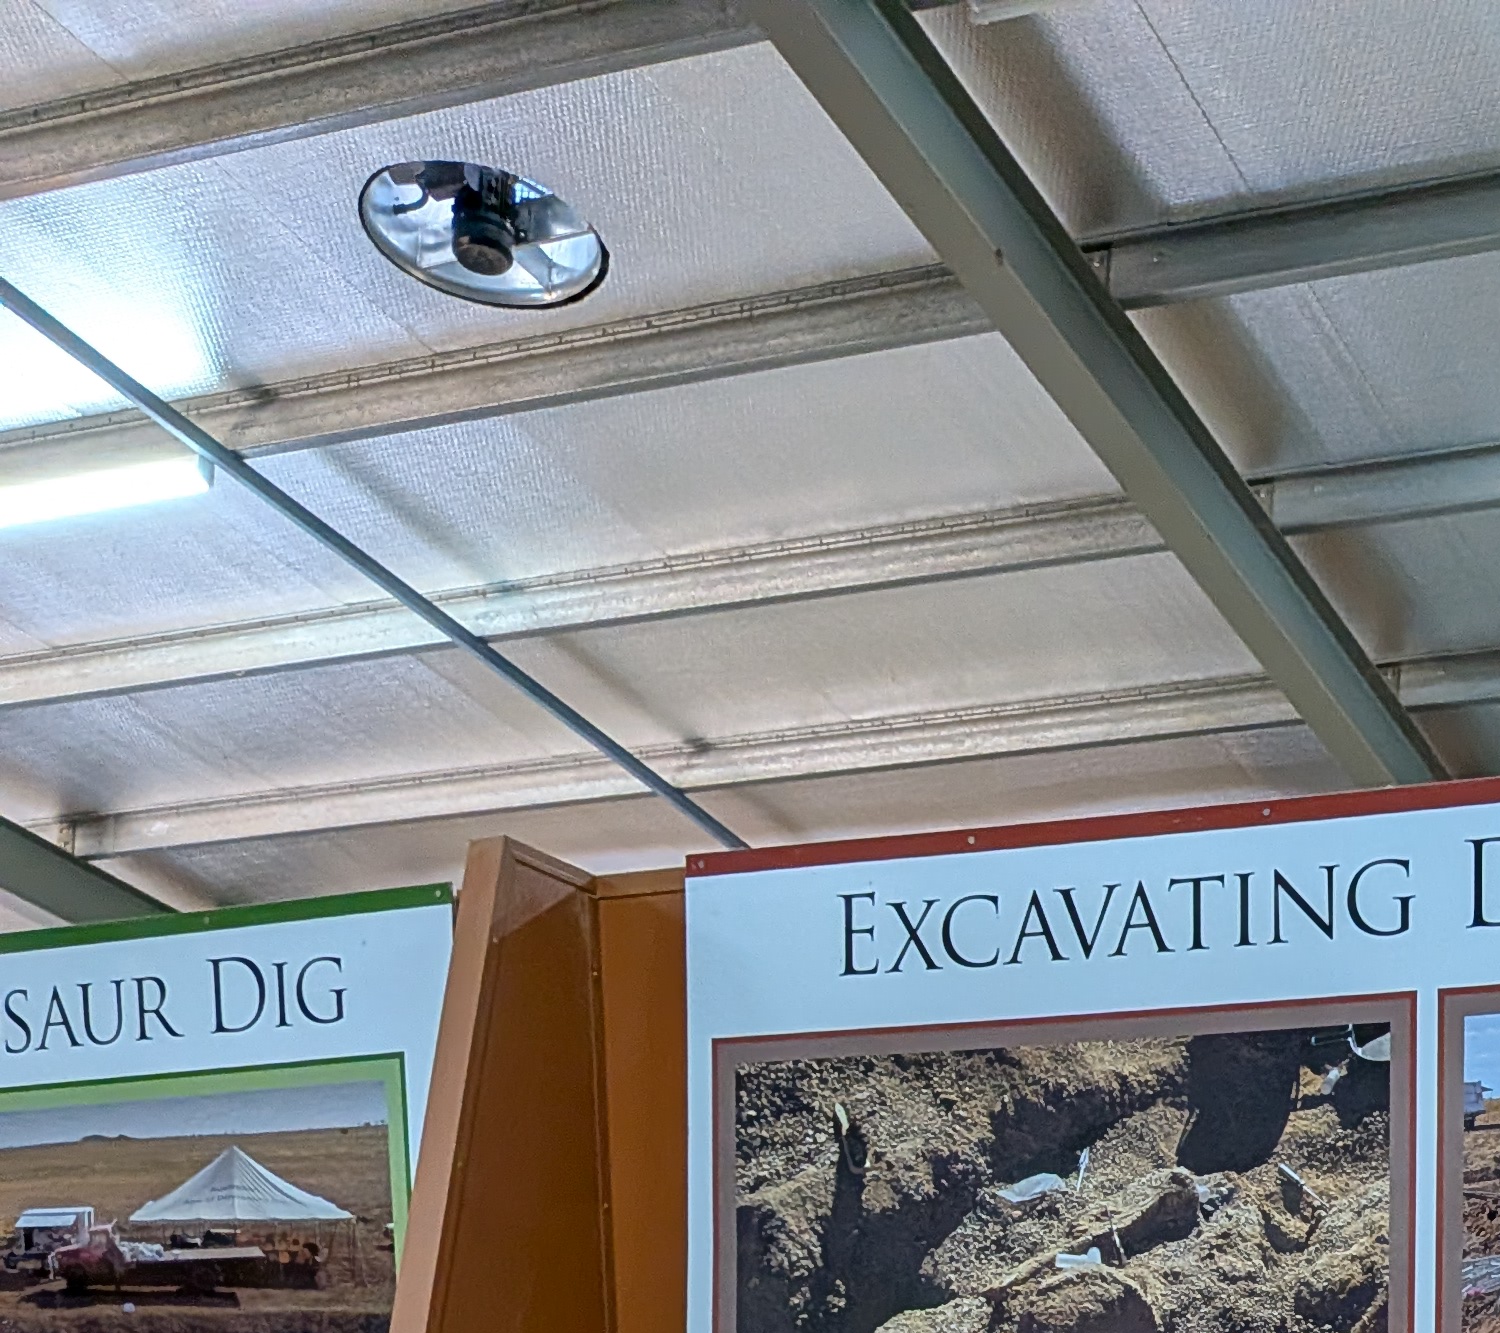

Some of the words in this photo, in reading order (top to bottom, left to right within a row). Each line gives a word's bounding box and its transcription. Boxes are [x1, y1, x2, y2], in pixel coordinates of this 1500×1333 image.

[839, 858, 1414, 977] EXCAVATING
[3, 976, 183, 1054] SAUR
[207, 956, 347, 1034] DIG
